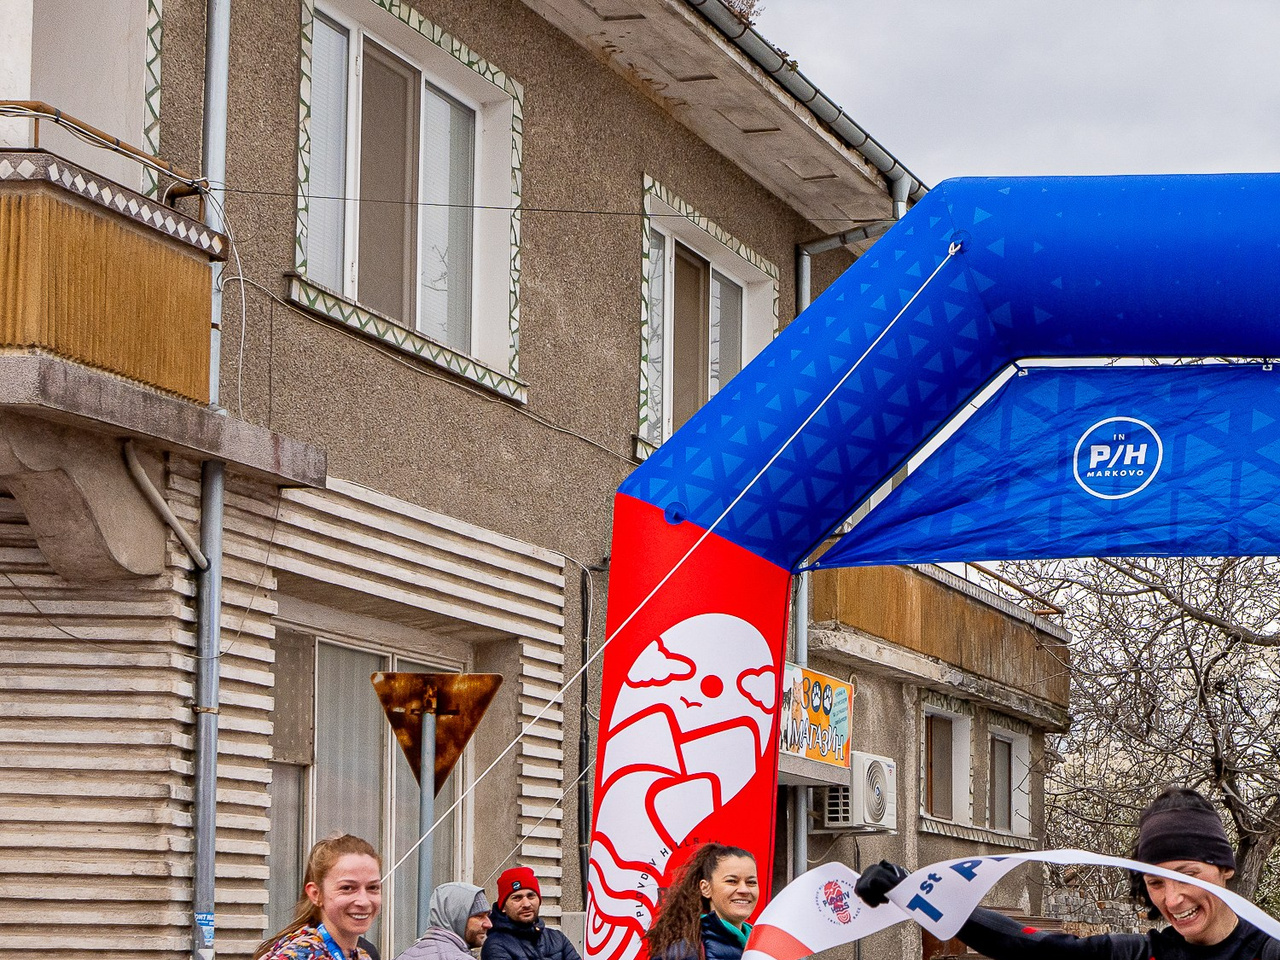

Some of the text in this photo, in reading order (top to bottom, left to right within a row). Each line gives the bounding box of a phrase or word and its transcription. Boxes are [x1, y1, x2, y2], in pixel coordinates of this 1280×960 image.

[1089, 443, 1148, 469] P/H
[1086, 469, 1144, 478] MARKOVO
[787, 717, 844, 760] МАГАЗИН
